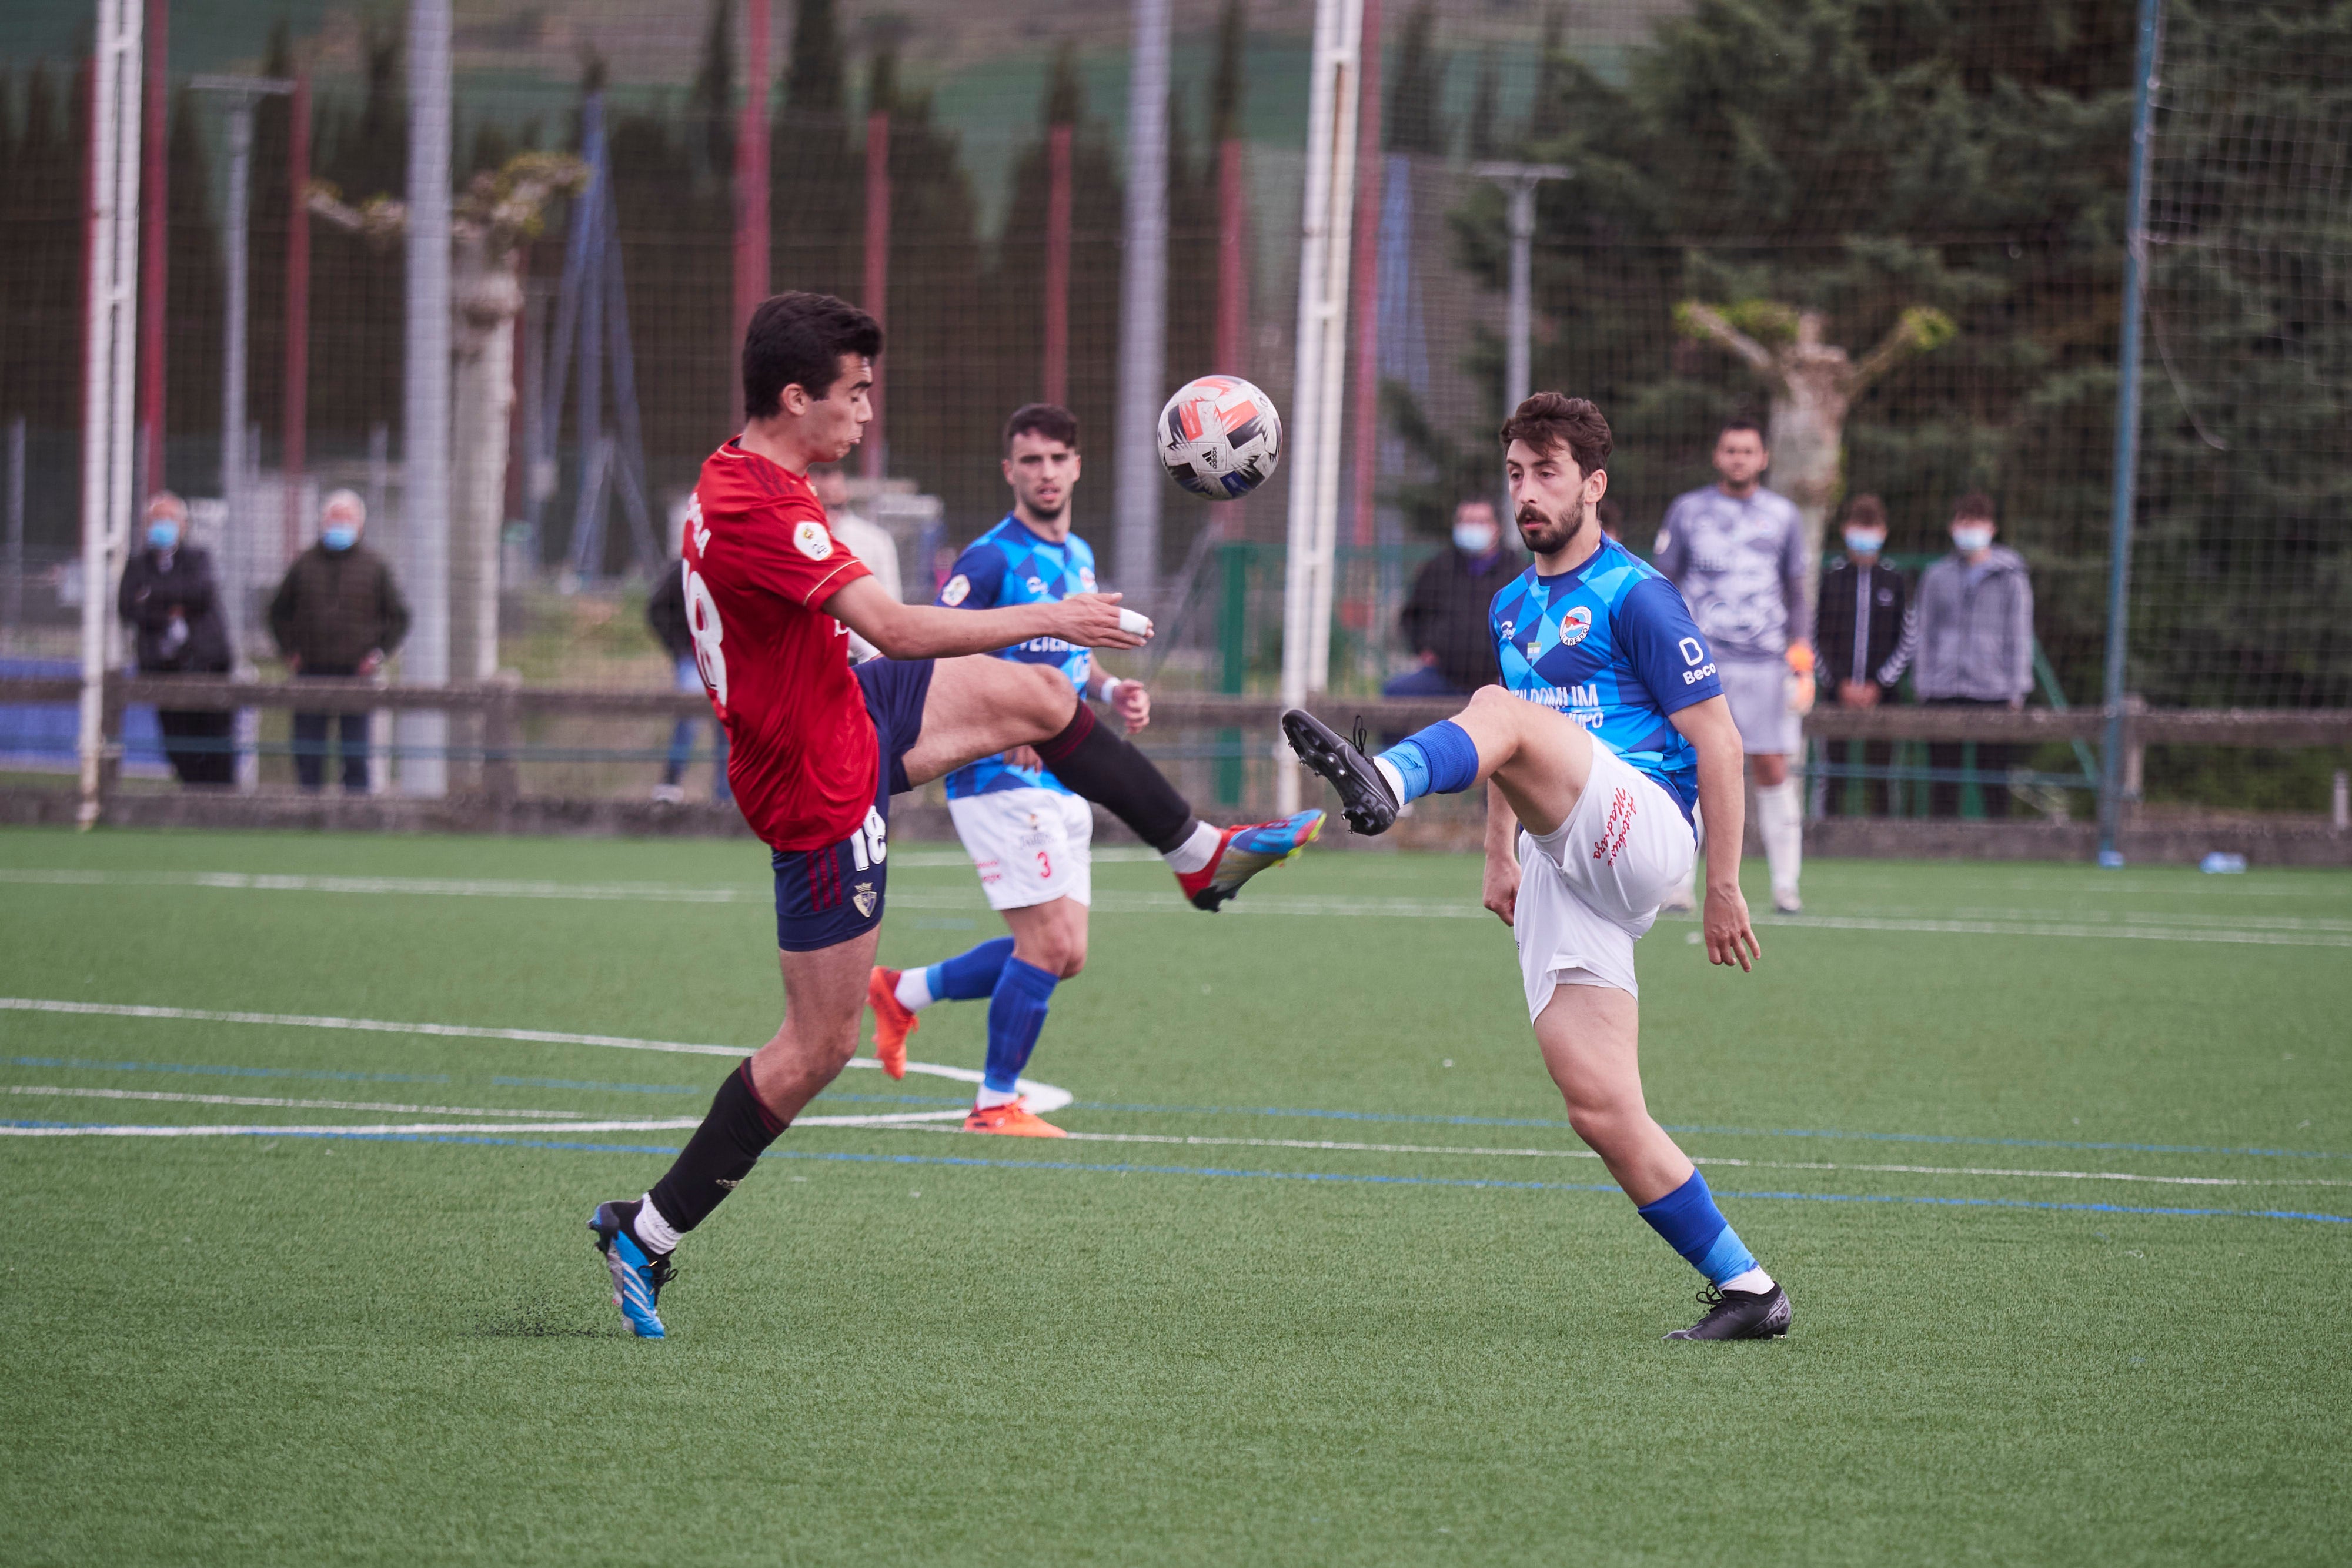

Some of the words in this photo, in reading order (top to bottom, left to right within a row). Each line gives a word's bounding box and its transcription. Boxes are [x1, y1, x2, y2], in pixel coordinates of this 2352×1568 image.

[1562, 628, 1588, 646] LAREDO
[1682, 663, 1716, 686] Beco
[850, 805, 887, 872] 18
[1036, 851, 1051, 878] 3
